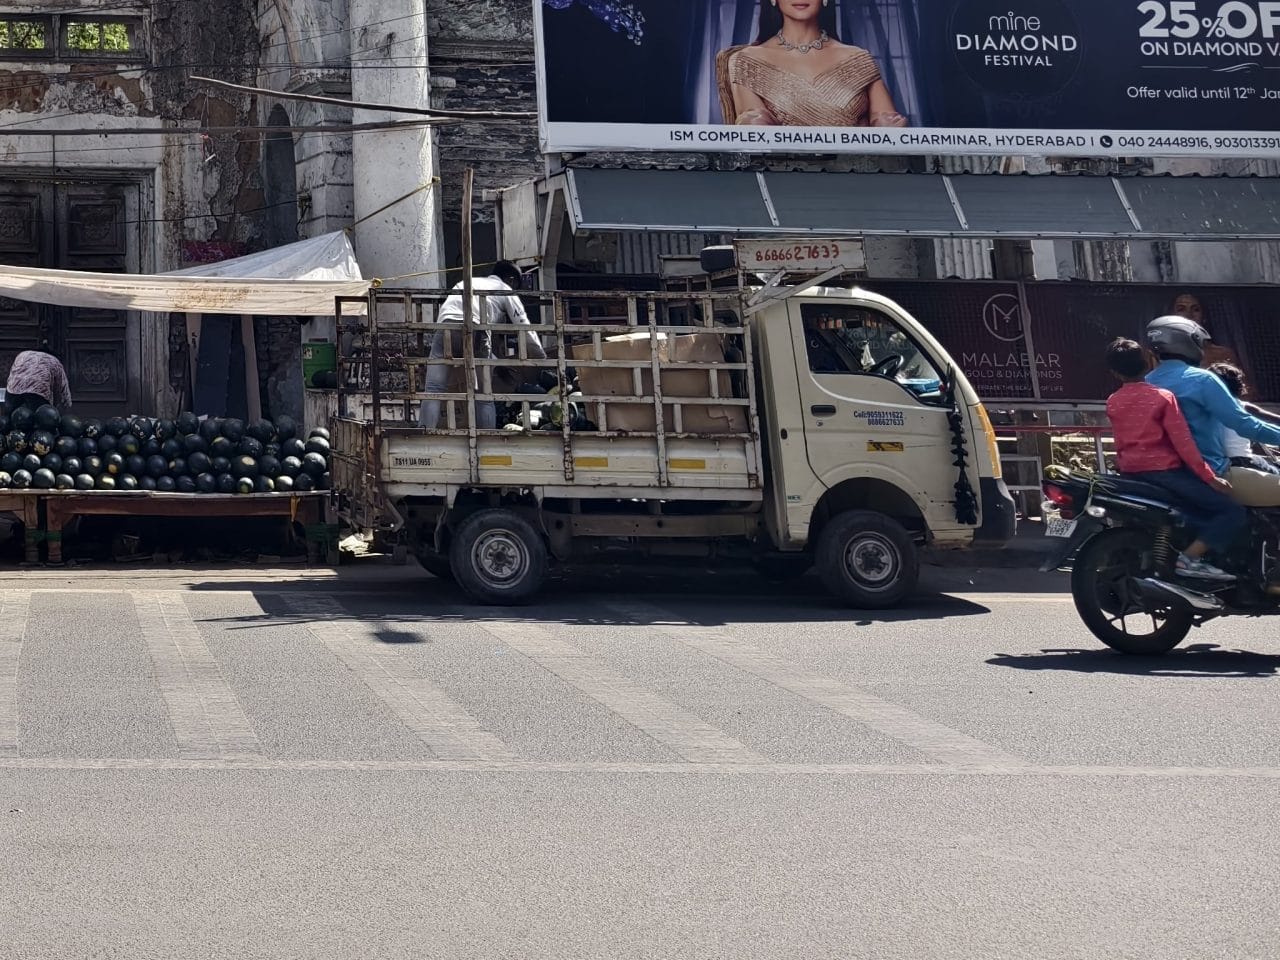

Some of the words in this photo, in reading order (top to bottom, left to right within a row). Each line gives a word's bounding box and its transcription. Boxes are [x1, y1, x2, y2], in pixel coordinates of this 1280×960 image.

[989, 11, 1041, 31] mine
[956, 34, 1077, 51] DIAMOND
[1140, 42, 1169, 56] ON
[1174, 42, 1262, 56] DIAMOND
[1266, 42, 1280, 56] V
[984, 55, 1053, 66] FESTIVAL
[1126, 86, 1161, 98] Offer
[1164, 87, 1197, 98] valid
[1201, 87, 1230, 99] until
[670, 130, 694, 141] ISM
[698, 130, 770, 144] COMPLEX,
[774, 132, 836, 144] SHAHALI
[841, 133, 896, 146] BANDA,
[900, 134, 992, 147] CHARMINAR,
[995, 135, 1086, 147] HYDERABAD
[1118, 136, 1145, 147] 040
[1148, 136, 1212, 149] 24448916,
